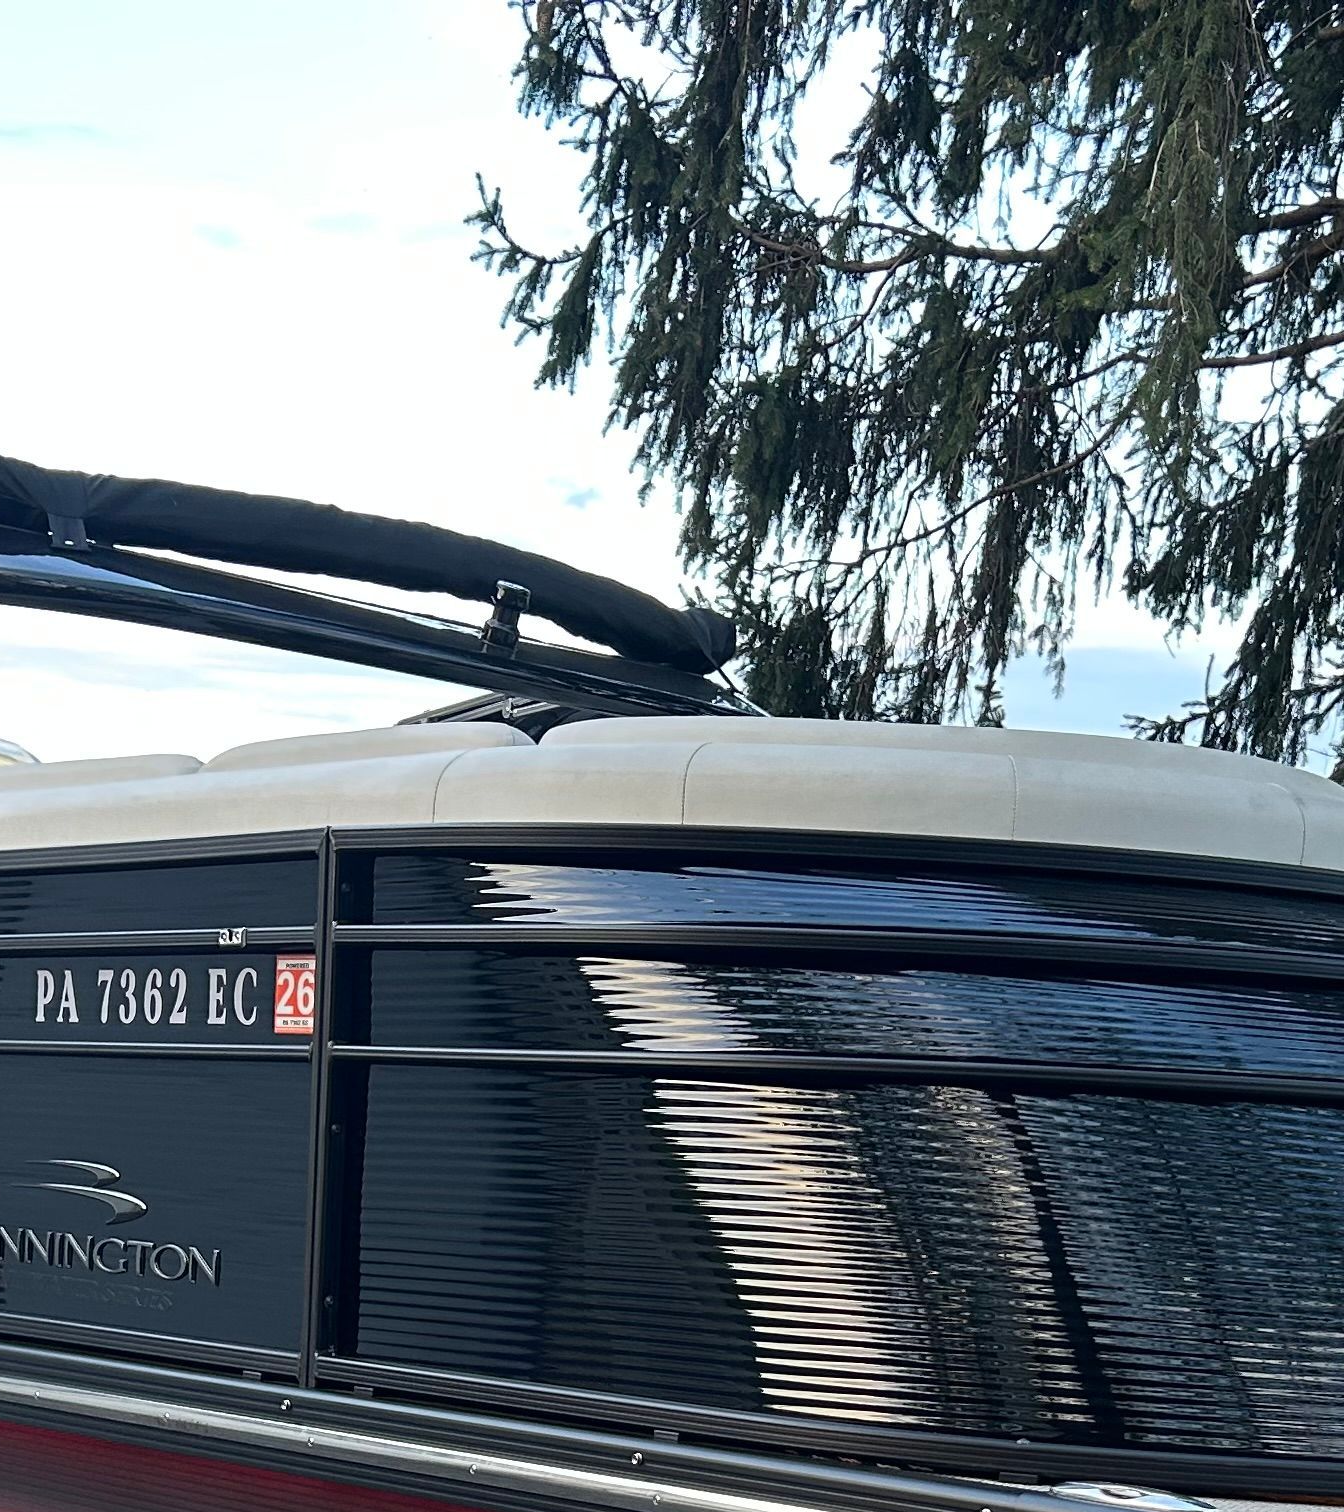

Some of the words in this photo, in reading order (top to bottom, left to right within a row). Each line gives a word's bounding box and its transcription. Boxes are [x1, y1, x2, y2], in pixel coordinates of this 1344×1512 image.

[35, 969, 79, 1023] PA
[97, 968, 188, 1024] 7362
[207, 967, 257, 1025] EC
[276, 970, 315, 1015] 26
